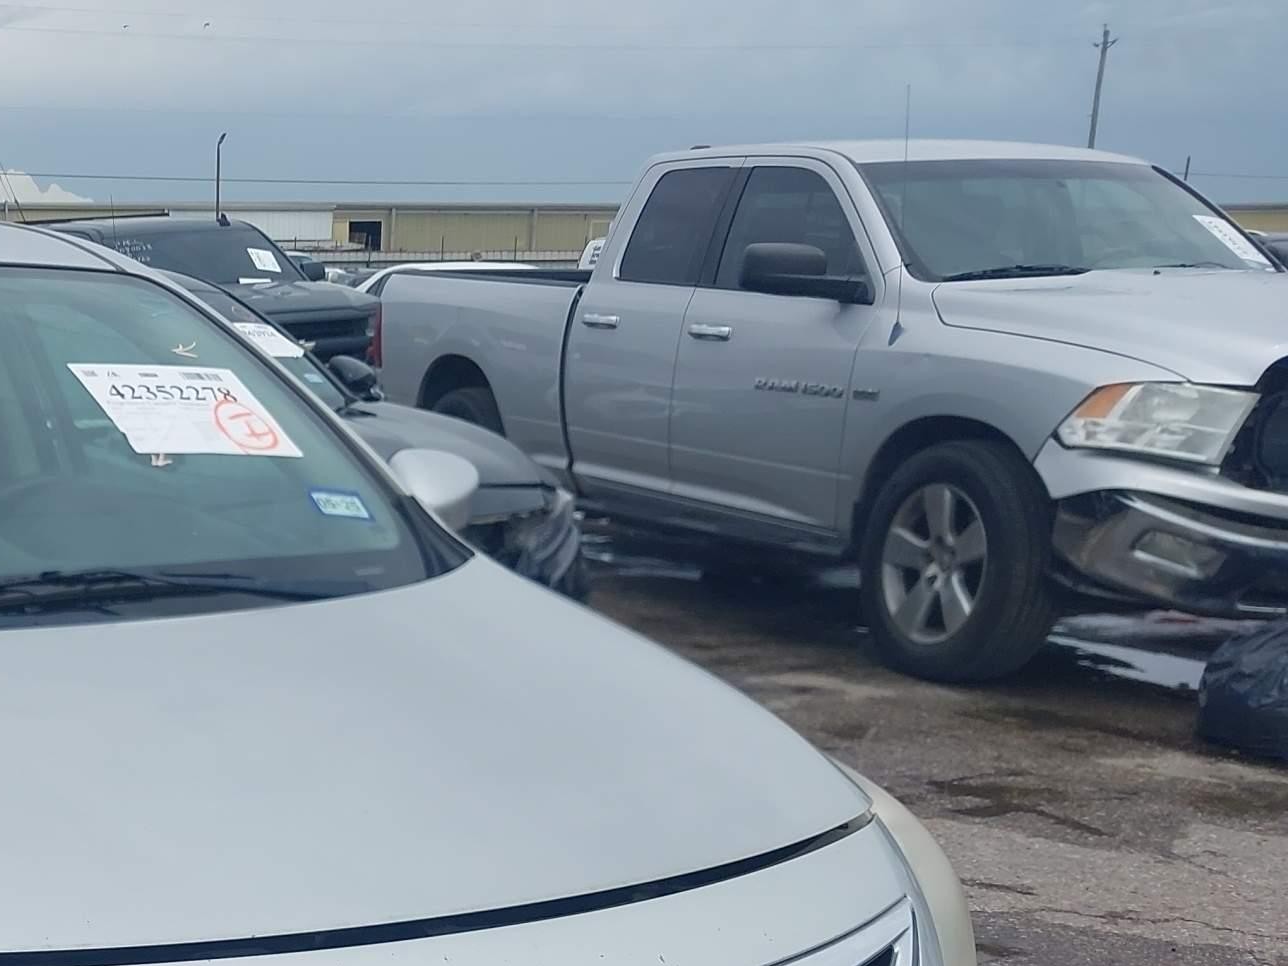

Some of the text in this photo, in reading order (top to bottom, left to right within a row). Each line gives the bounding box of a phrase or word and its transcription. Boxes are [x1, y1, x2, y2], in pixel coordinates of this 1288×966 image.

[108, 384, 239, 403] 42352278
[754, 377, 800, 394] RAM
[801, 382, 844, 399] 1500
